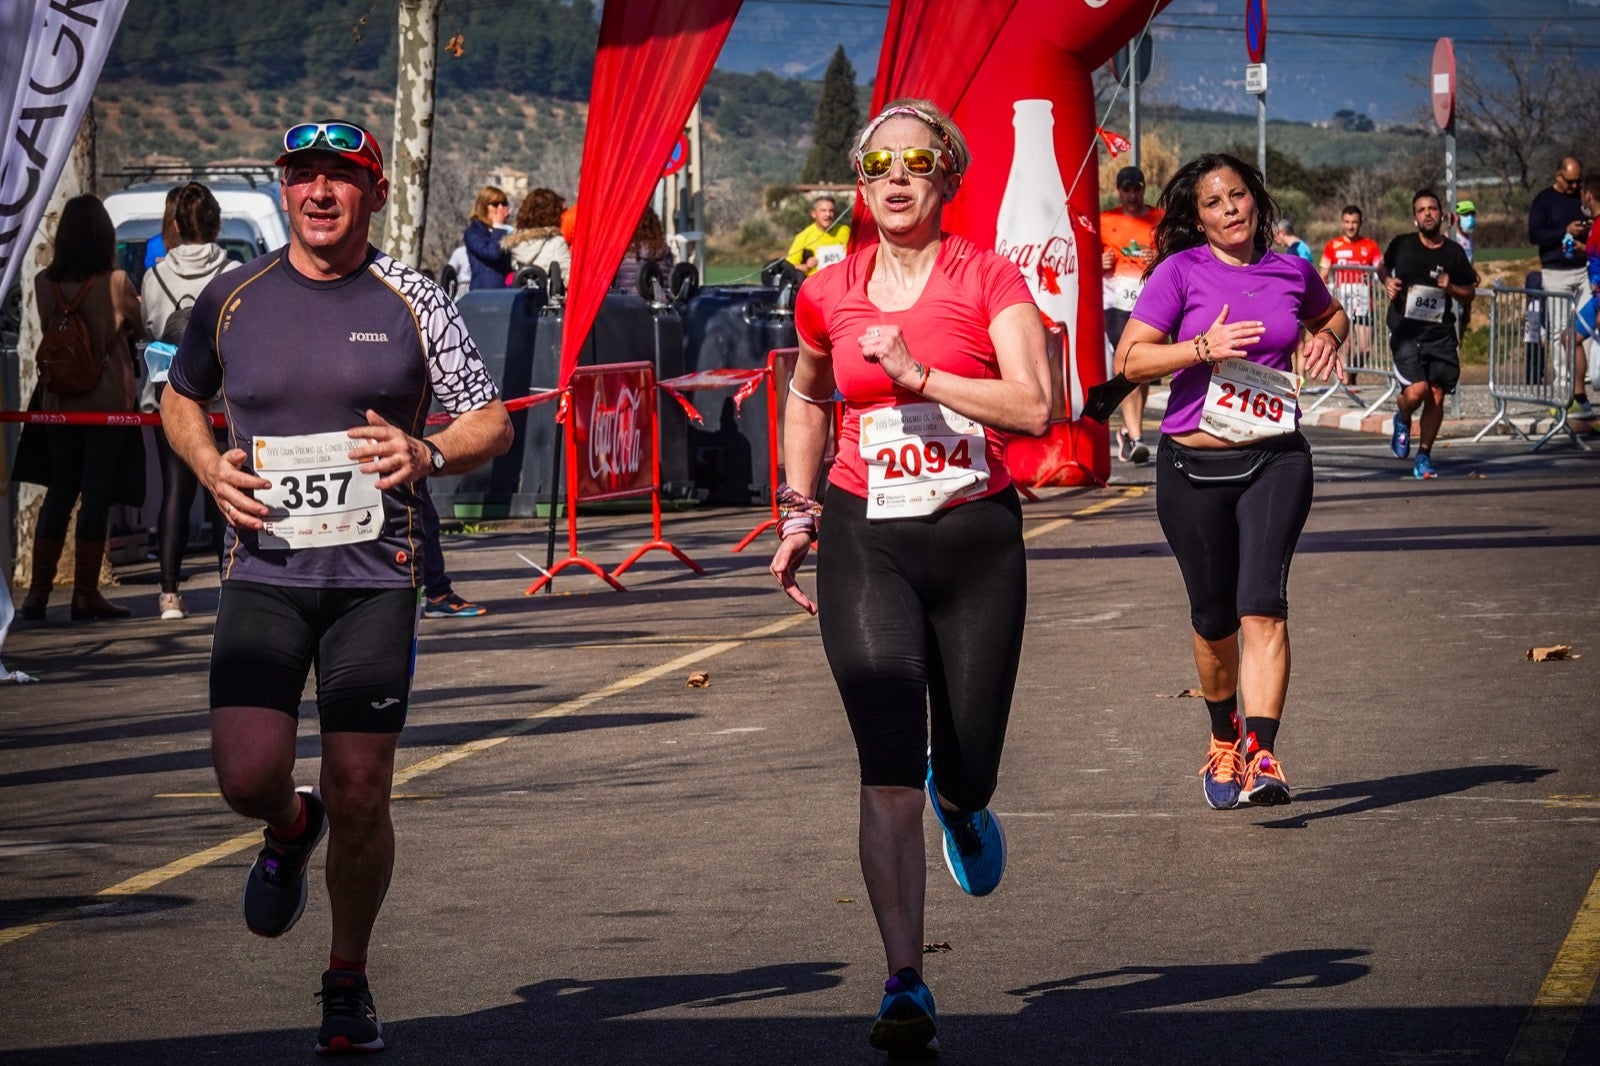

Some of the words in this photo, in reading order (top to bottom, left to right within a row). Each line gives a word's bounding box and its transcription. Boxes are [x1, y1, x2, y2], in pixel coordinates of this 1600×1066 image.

[1415, 296, 1437, 309] 842
[1216, 382, 1284, 423] 2169
[876, 439, 972, 480] 2094
[280, 471, 353, 510] 357
